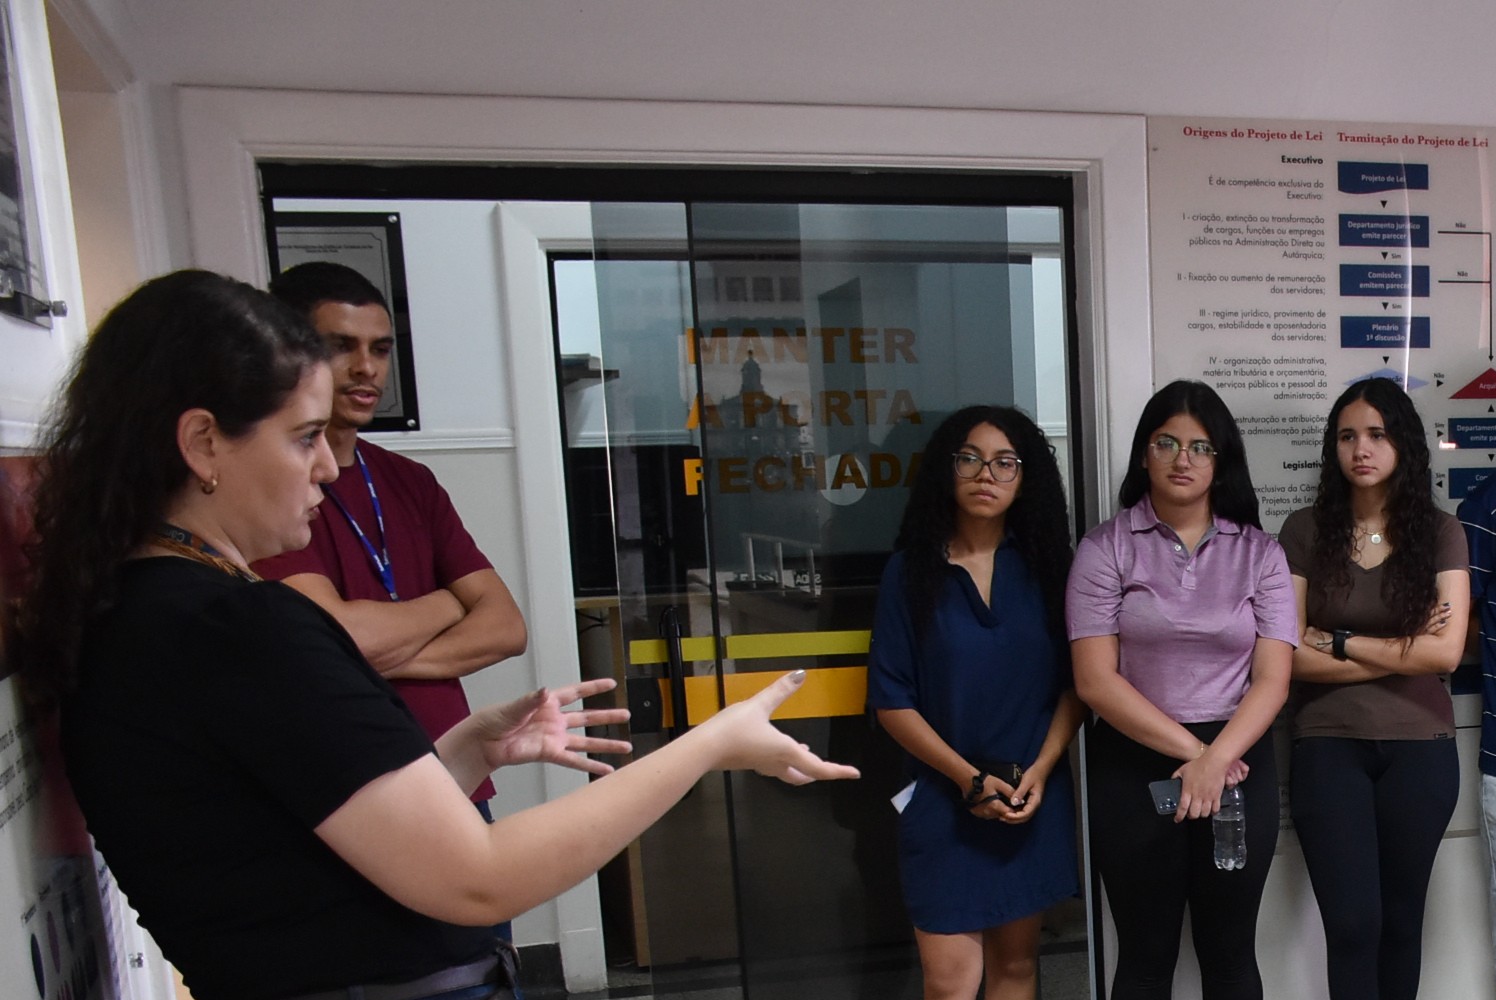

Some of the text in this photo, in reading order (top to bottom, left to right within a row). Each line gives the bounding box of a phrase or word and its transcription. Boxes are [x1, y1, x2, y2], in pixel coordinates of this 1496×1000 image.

[1182, 126, 1323, 142] Origens do Projeto de Lei
[1337, 132, 1488, 148] Tramitação do Projeto de Lei
[1280, 154, 1324, 165] Executivo
[1216, 177, 1324, 189] de competência exclusiva do
[1361, 174, 1385, 184] Projeto
[1192, 212, 1224, 224] criação,
[1226, 214, 1258, 224] extinção
[1272, 214, 1324, 224] transformação
[1347, 221, 1394, 230] Departamento
[1204, 226, 1214, 236] de
[1216, 228, 1244, 237] cargos,
[1246, 226, 1274, 236] funções
[1288, 230, 1325, 238] empregos
[1188, 238, 1221, 246] públicos
[1235, 238, 1288, 248] Administração
[1292, 239, 1314, 247] Direta
[1282, 250, 1325, 260] Autárquica;
[1188, 272, 1218, 283] fixação
[1266, 274, 1276, 282] de
[1278, 274, 1326, 284] remuneração
[1368, 271, 1402, 279] Comissões
[1270, 286, 1326, 295] dos servidores;
[1212, 310, 1238, 319] regime
[1274, 310, 1314, 320] provimento
[1316, 310, 1326, 318] de
[1218, 321, 1264, 330] estabilidade
[1273, 321, 1326, 331] aposentadoria
[1372, 324, 1399, 332] Plenário
[1271, 333, 1285, 342] dos
[686, 328, 920, 364] MANTER
[1224, 357, 1271, 367] organização
[1273, 357, 1327, 366] administrativa,
[1233, 369, 1267, 377] tributária
[1276, 369, 1327, 378] orçamentária,
[1216, 381, 1246, 390] serviços
[1248, 380, 1279, 390] públicos
[1288, 380, 1316, 389] pessoal
[1273, 392, 1327, 401] administração;
[685, 389, 923, 430] A PORTA
[1288, 415, 1328, 424] atribuições
[1248, 427, 1300, 436] administração
[1283, 461, 1322, 471] Legislativ
[1288, 484, 1298, 492] da
[1261, 496, 1290, 506] Projetos
[1292, 495, 1302, 504] de
